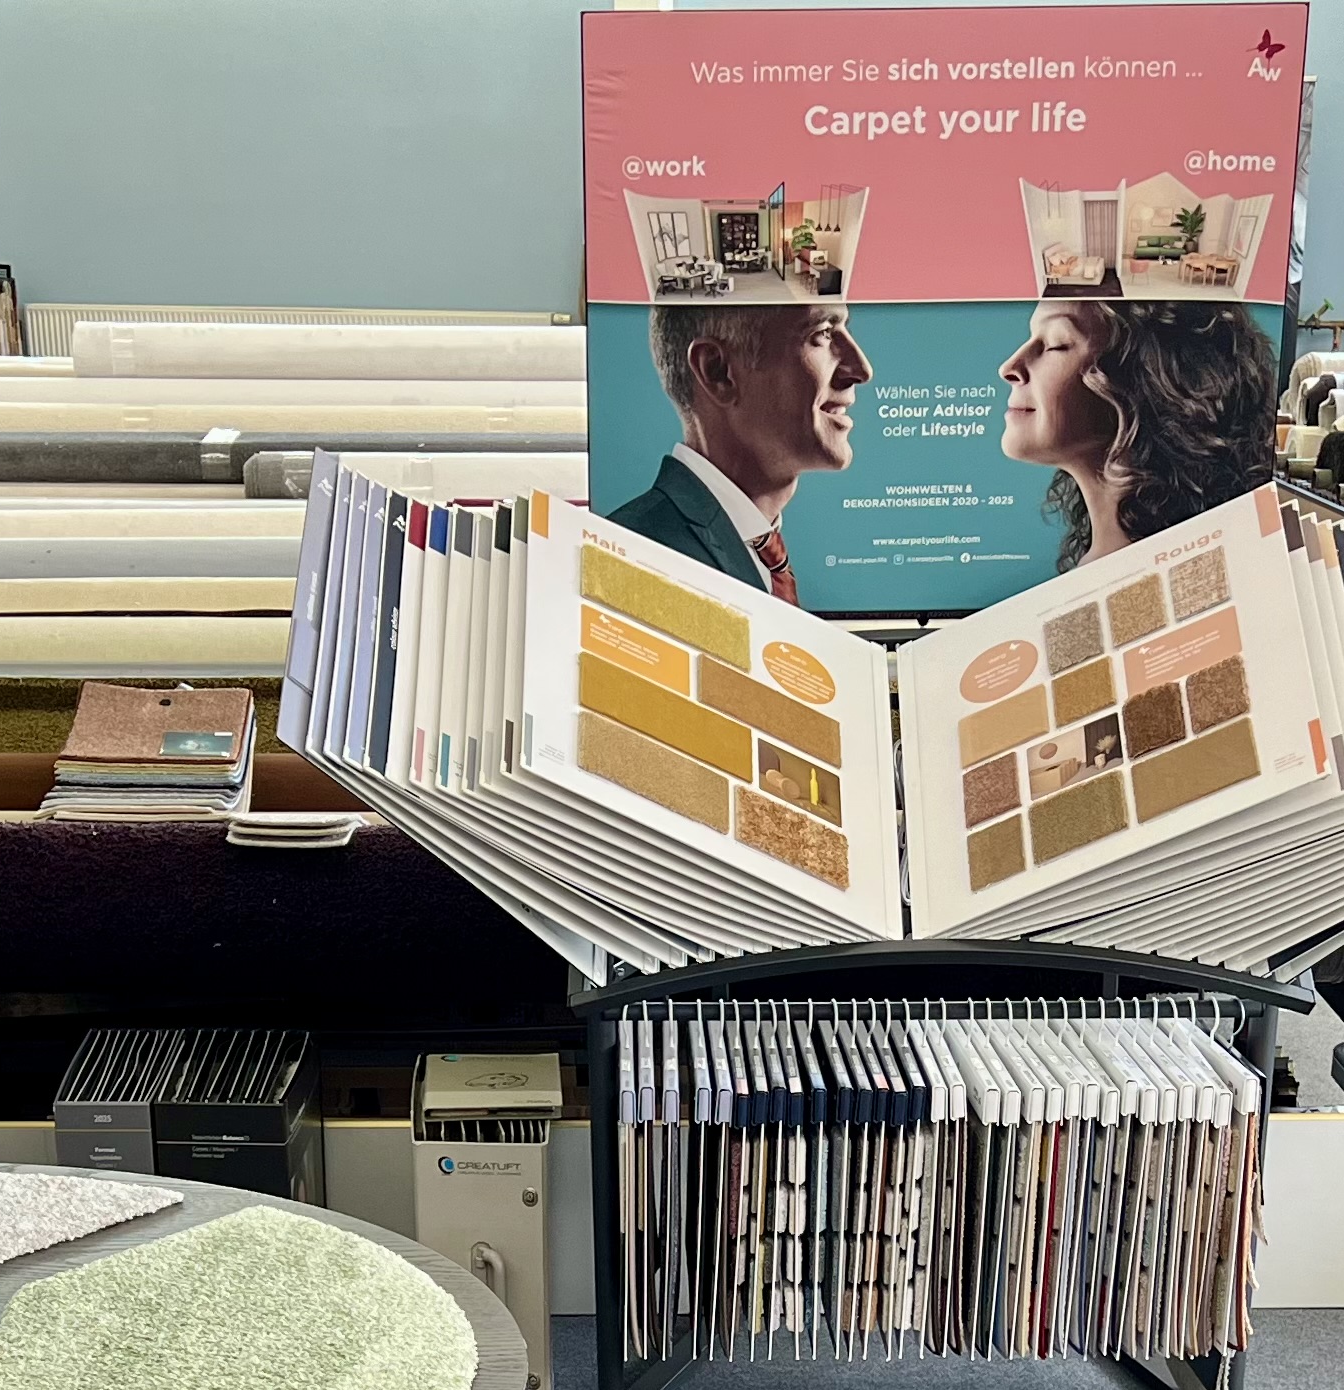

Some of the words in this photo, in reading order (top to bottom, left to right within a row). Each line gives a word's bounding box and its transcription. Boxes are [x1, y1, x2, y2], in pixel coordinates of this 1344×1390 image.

[690, 60, 744, 84] Was
[753, 60, 833, 84] immer
[842, 58, 880, 82] Sie
[887, 57, 939, 82] sich
[947, 56, 1076, 81] vorstellen
[1084, 55, 1177, 79] können
[804, 105, 927, 140] Carpet
[938, 107, 1020, 140] your
[1031, 101, 1087, 133] life
[621, 154, 707, 181] @work
[1183, 150, 1277, 175] @home
[875, 385, 930, 400] Wählen
[934, 384, 957, 399] Sie
[960, 384, 996, 399] nach
[878, 405, 929, 419] Colour
[933, 403, 992, 418] Advisor
[882, 424, 917, 438] oder
[921, 422, 985, 438] Lifestyle
[885, 485, 963, 496] WOHNWELTEN
[843, 497, 950, 508] DEKORATIONSIDEEN
[582, 528, 626, 557] Mais
[872, 534, 981, 547] www.carpetyourlife.com
[1154, 528, 1224, 566] Rouge
[457, 1161, 522, 1171] CREATUFT
